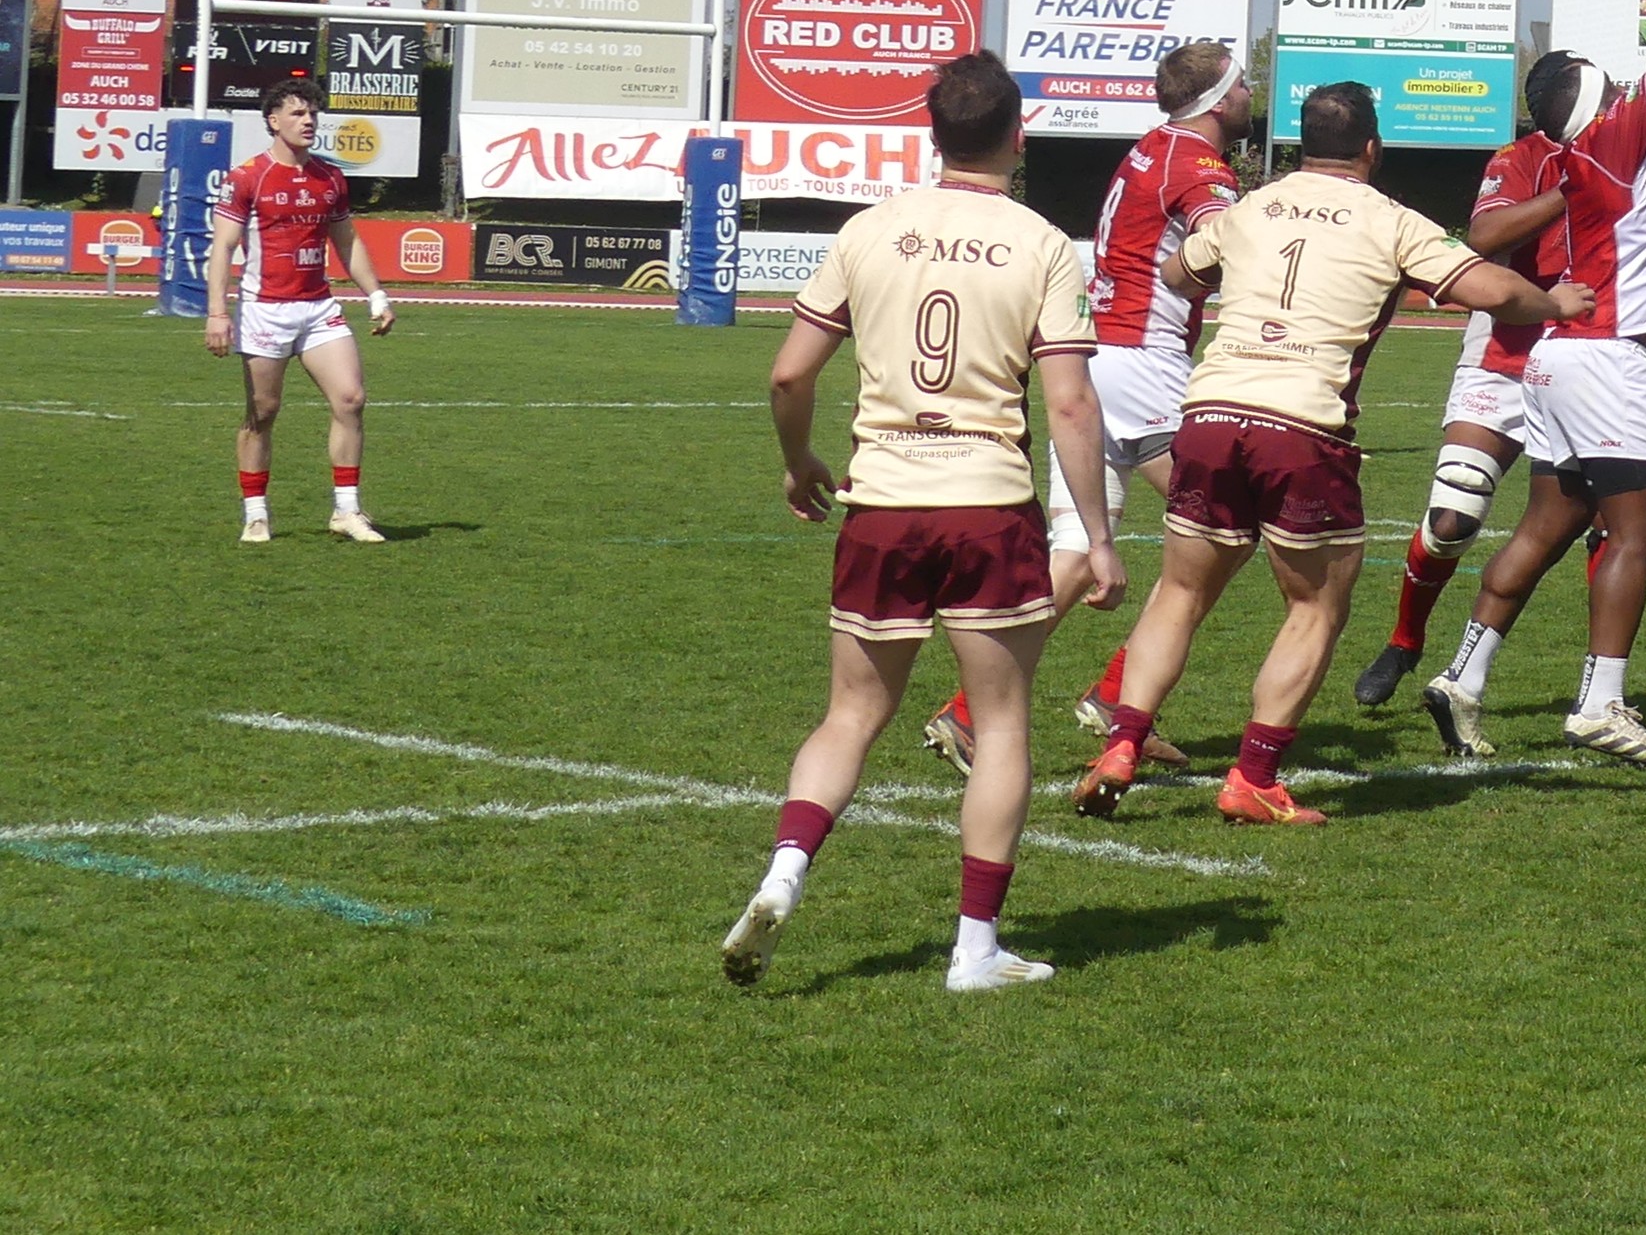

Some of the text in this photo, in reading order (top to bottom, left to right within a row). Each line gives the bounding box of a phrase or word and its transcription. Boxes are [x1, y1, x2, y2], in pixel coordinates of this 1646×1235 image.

[763, 20, 956, 52] RED CLUB
[255, 39, 312, 55] VISIT
[525, 40, 643, 57] 05 42 54 10 20
[489, 58, 677, 74] Achat Vente Location Gestion
[90, 75, 129, 88] AUCH
[1418, 67, 1473, 81] Un projet
[223, 85, 261, 98] Bodet
[329, 72, 419, 96] BRASSERIE
[621, 83, 680, 95] CENTURY 21
[1048, 81, 1156, 96] AUCH 05 62 6
[1407, 80, 1473, 94] immobilier
[62, 92, 155, 107] 05 32 46 00 58
[328, 94, 418, 112] MOUSSEQUETAIRE
[1052, 106, 1099, 122] Agréé
[674, 128, 921, 184] UCH
[748, 178, 790, 192] TOUS
[804, 179, 847, 194] TOUS
[851, 183, 894, 198] POUR
[1289, 205, 1352, 226] MSC
[28, 221, 66, 235] unique
[3, 236, 64, 247] vos travaux
[103, 235, 141, 244] BURGER
[585, 236, 662, 251] 05 62 67 77 08
[404, 243, 441, 253] BURGER
[738, 245, 829, 264] PYRÉNÉ
[929, 238, 1012, 267] MSC
[404, 252, 440, 263] KING
[584, 258, 628, 270] GIMONT
[737, 265, 821, 281] GASCO
[1279, 238, 1306, 310] 1
[910, 289, 960, 394] 9
[904, 447, 974, 462] dupasquier
